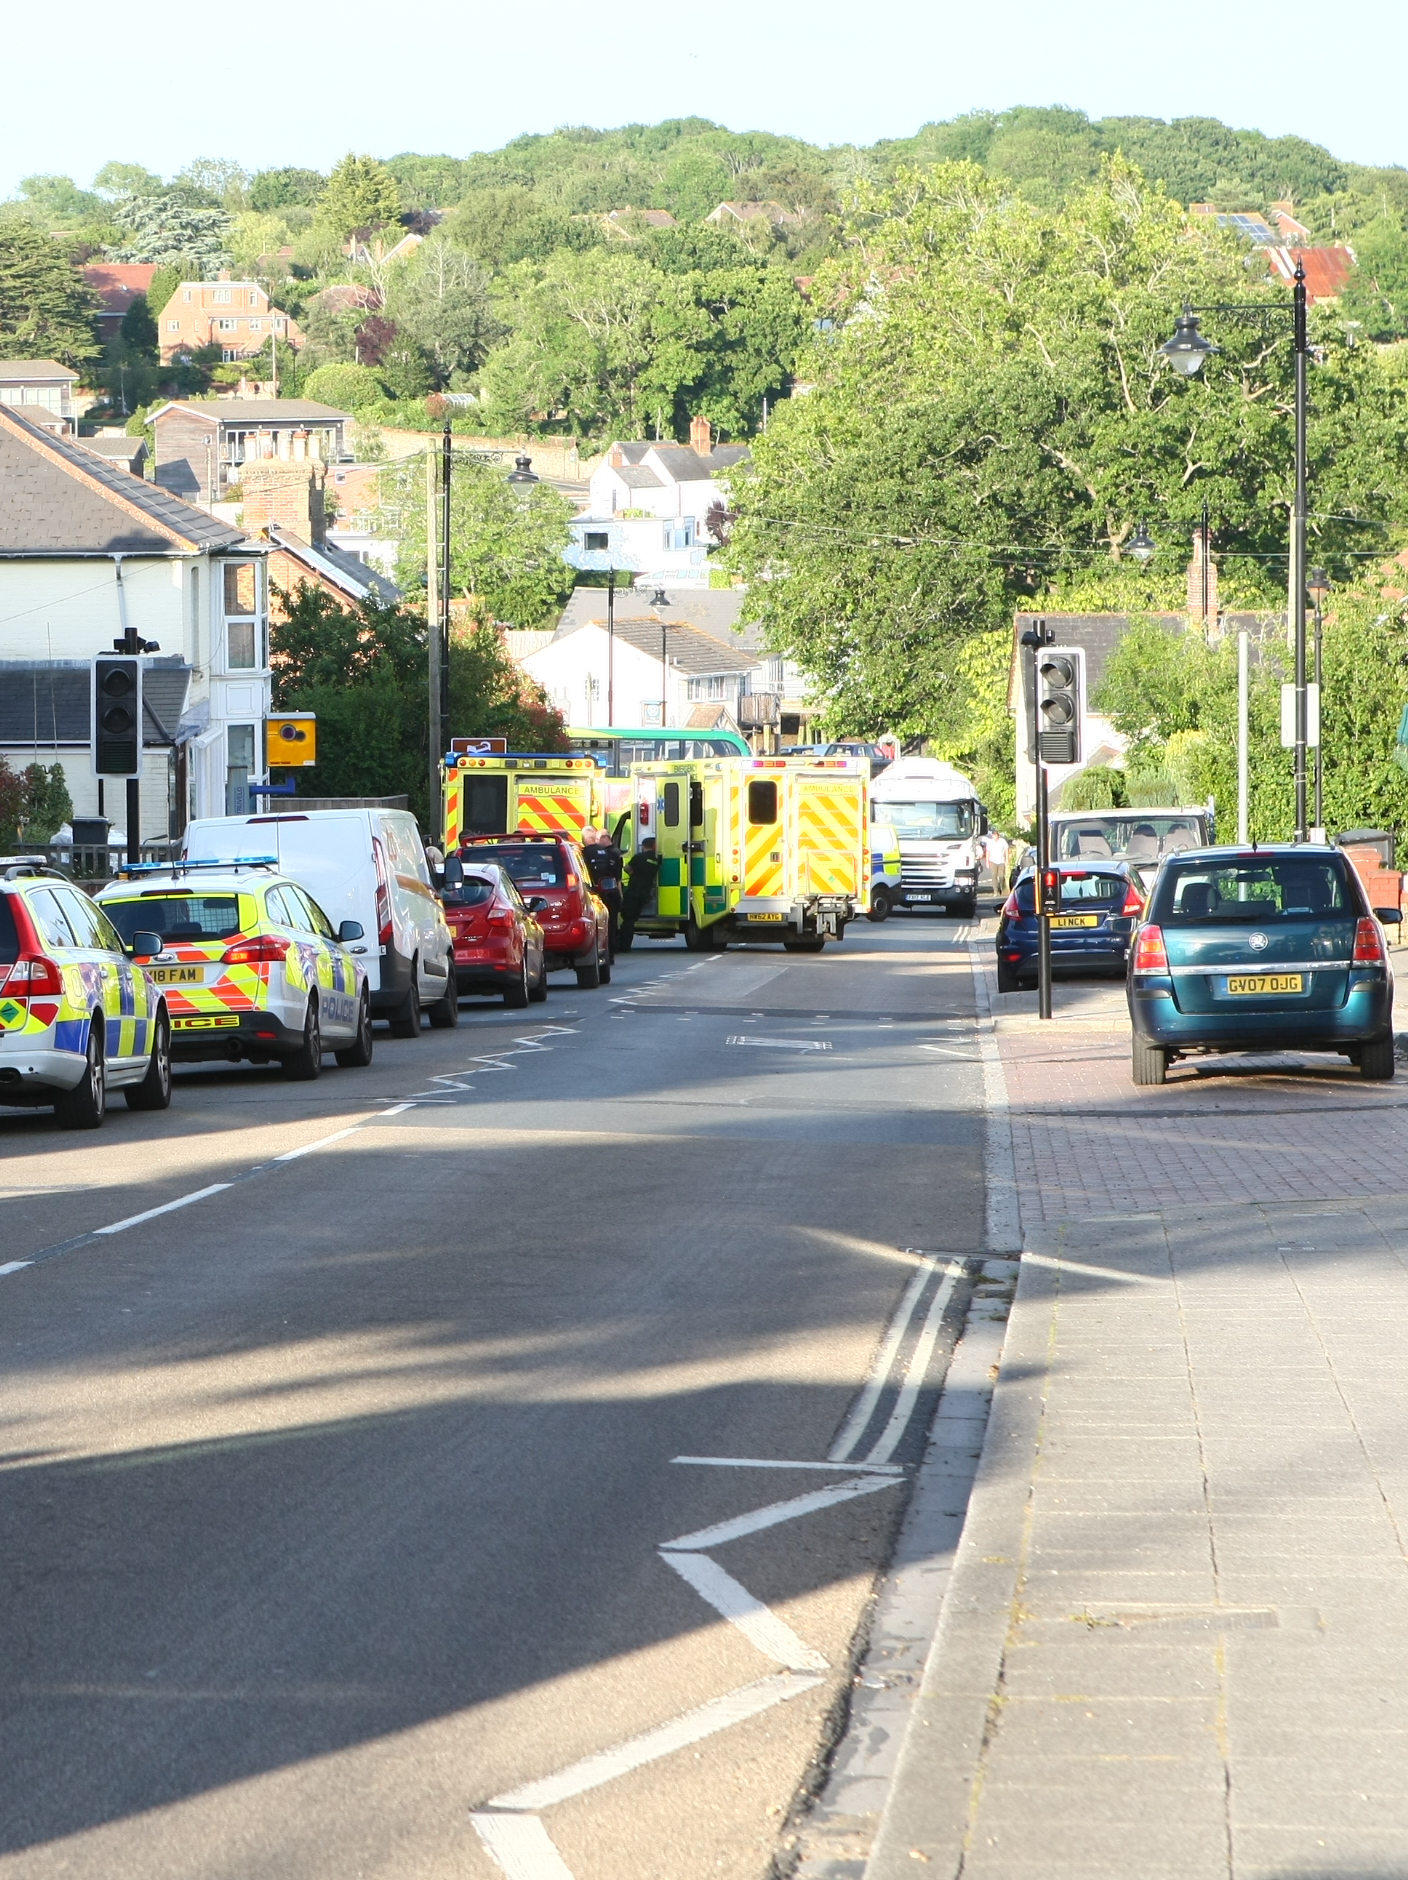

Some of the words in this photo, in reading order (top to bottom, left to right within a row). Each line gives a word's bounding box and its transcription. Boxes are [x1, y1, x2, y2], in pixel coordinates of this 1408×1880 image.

[523, 786, 579, 795] AMBULANCE
[802, 785, 854, 793] AMBULANCE
[169, 968, 196, 982] FAM
[1229, 978, 1266, 992] GV07
[322, 995, 354, 1023] POLICE
[171, 1016, 239, 1029] ICE
